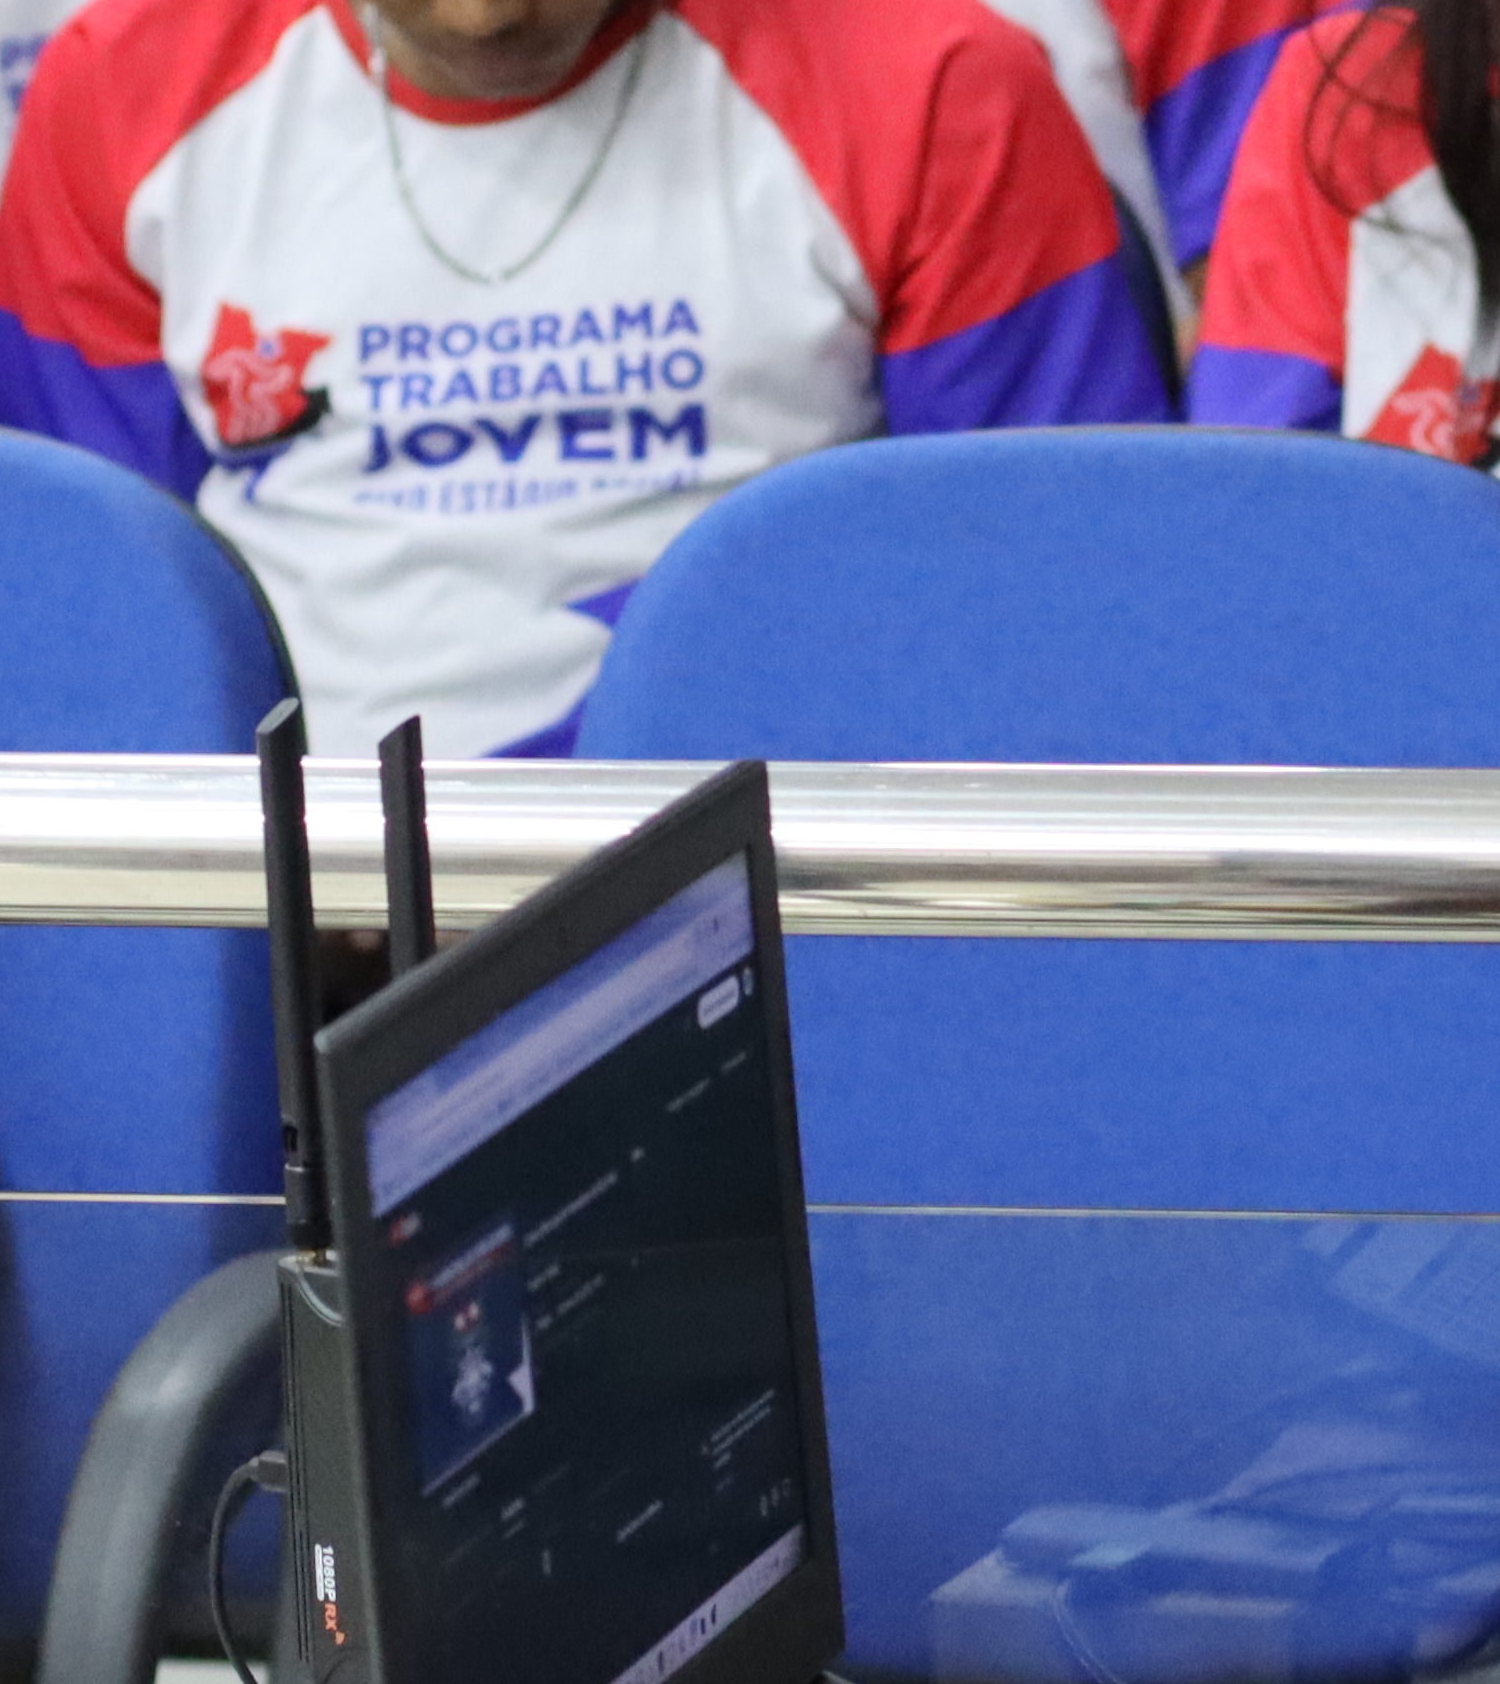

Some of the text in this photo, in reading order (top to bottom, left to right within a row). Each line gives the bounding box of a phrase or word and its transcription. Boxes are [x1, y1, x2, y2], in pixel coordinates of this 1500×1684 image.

[358, 299, 700, 362] PROGRAMA
[360, 348, 705, 412] TRABALHO
[363, 402, 708, 474] JOVEM
[323, 1546, 337, 1630] 1080P RX
